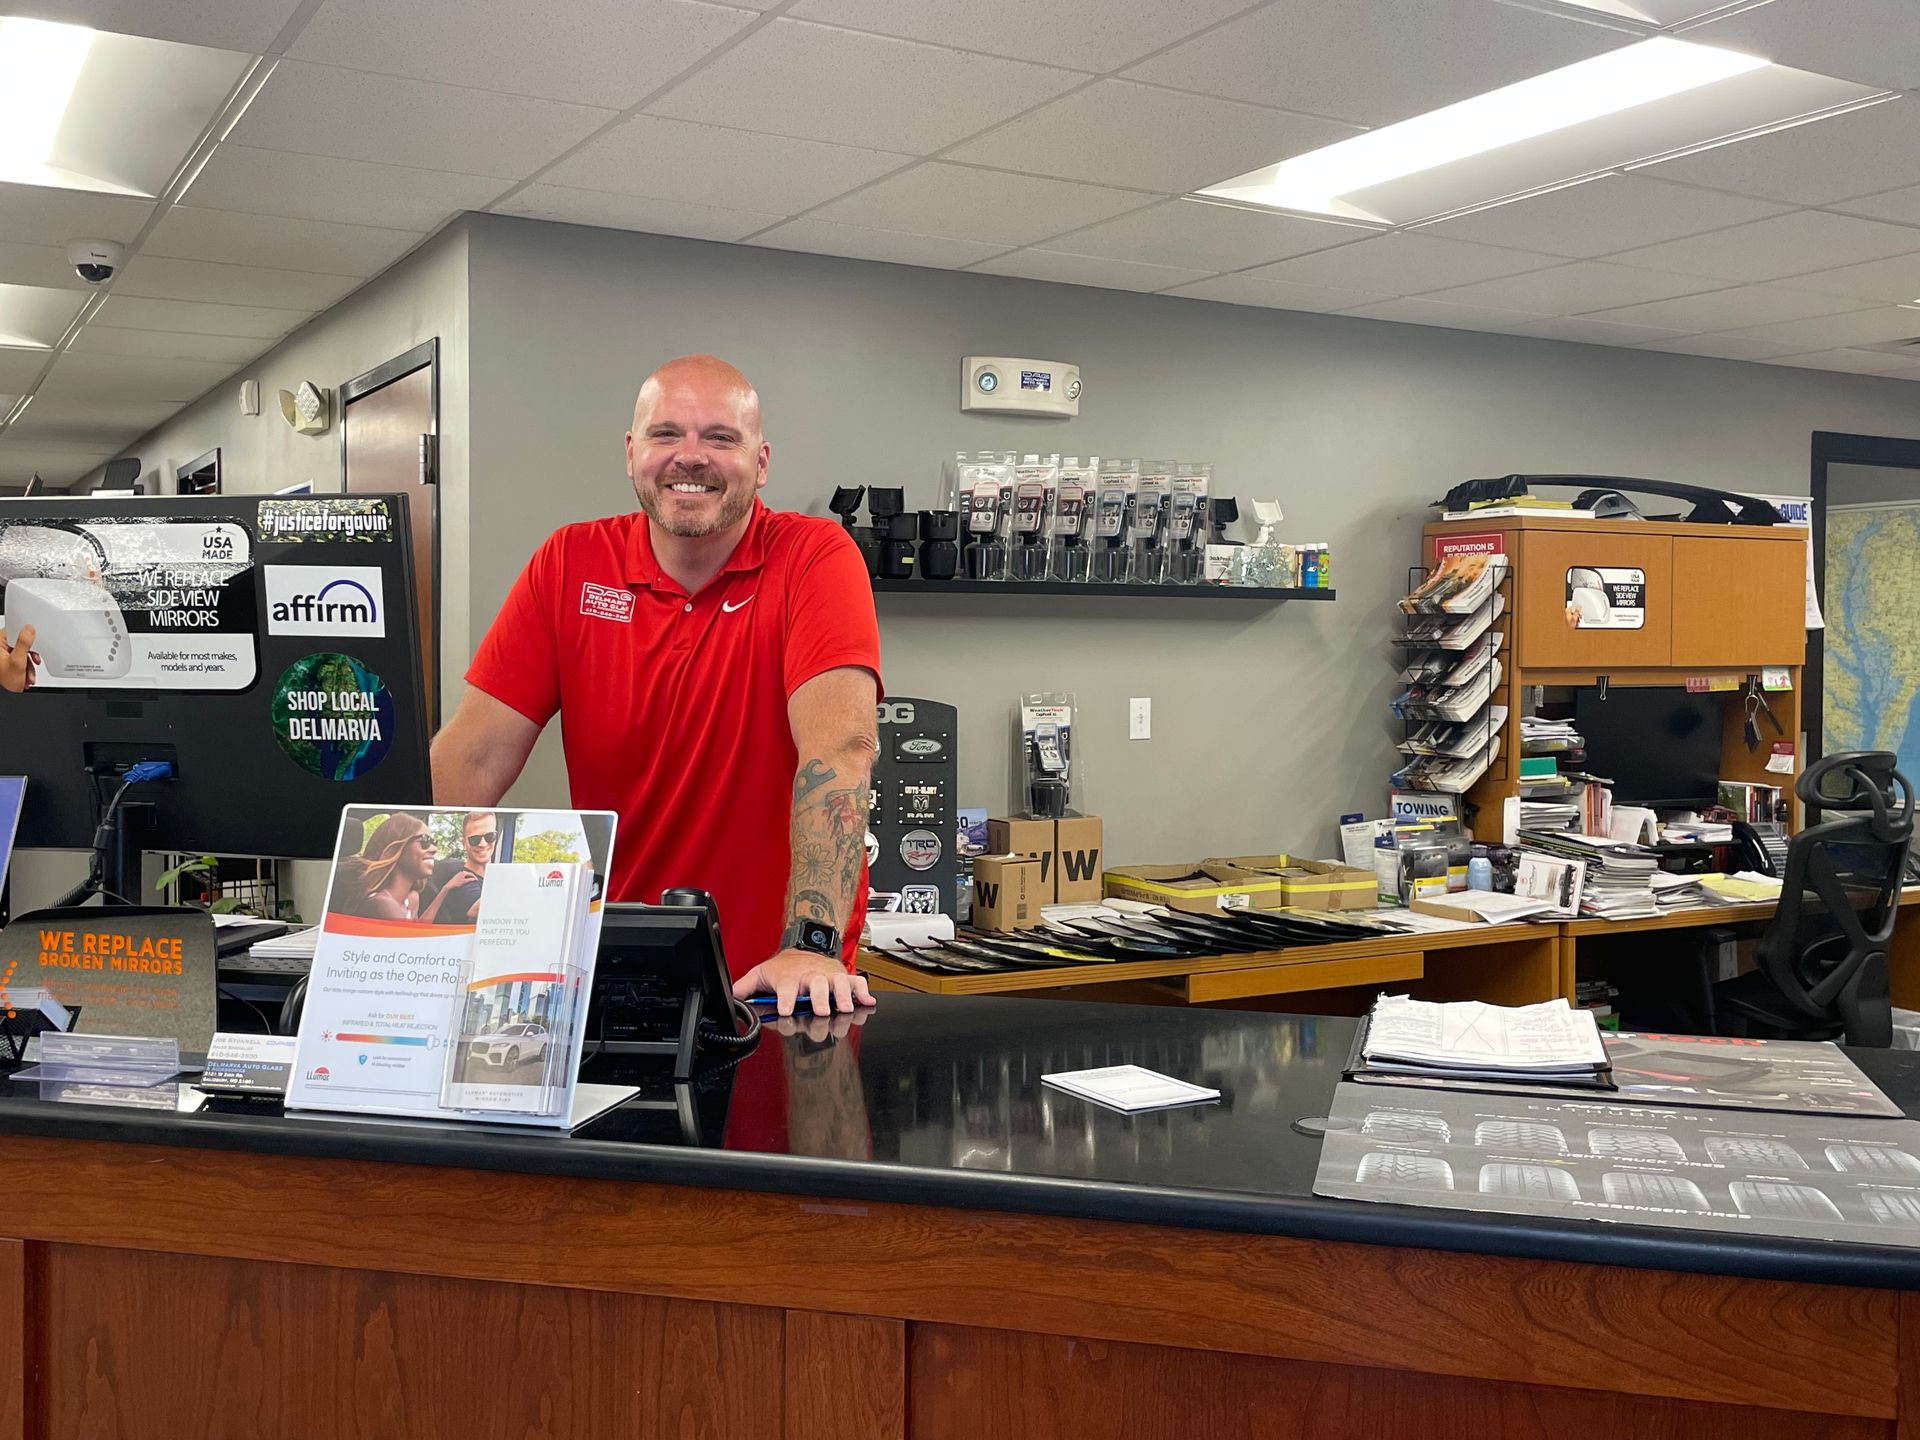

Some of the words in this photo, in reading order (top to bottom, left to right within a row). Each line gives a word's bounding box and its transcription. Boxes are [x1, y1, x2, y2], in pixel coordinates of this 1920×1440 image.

[1781, 504, 1807, 520] GUIDE
[262, 508, 388, 536] #justiceforgavin
[203, 537, 233, 549] USA
[1443, 544, 1487, 553] REPUTATION
[1488, 542, 1495, 551] IS
[201, 550, 233, 560] MADE
[139, 571, 164, 587] WE
[164, 571, 229, 587] REPLACE
[586, 586, 632, 601] DAG
[272, 594, 369, 623] affirm
[149, 610, 220, 627] MIRRORS
[147, 651, 178, 660] Available
[179, 652, 190, 661] for
[190, 653, 211, 661] most
[212, 652, 238, 662] makes,
[161, 663, 187, 672] models
[189, 663, 203, 672] and
[204, 664, 226, 674] years.
[287, 691, 328, 711] SHOP
[332, 692, 379, 712] LOCAL
[289, 717, 382, 741] DELMARVA
[909, 741, 934, 751] Ford
[1396, 802, 1450, 816] TOWING
[906, 840, 936, 850] TRD
[1063, 850, 1099, 882] W
[976, 880, 999, 909] W
[516, 928, 530, 936] YOU
[39, 930, 75, 952] WE
[83, 933, 183, 960] REPLACE
[480, 938, 517, 946] PERFECTLY
[38, 952, 104, 970] BROKEN
[110, 957, 183, 976] MIRRORS
[342, 950, 370, 963] Style
[373, 952, 396, 964] and
[398, 953, 446, 966] Comfort
[448, 958, 462, 967] as
[326, 966, 368, 982] Inviting
[370, 971, 384, 981] as
[386, 970, 404, 982] the
[408, 971, 439, 985] Open
[1612, 1156, 1668, 1164] TRUCK
[1674, 1160, 1726, 1168] TIRES
[1572, 1200, 1688, 1214] PASSENGER
[1695, 1210, 1752, 1219] TIRES
